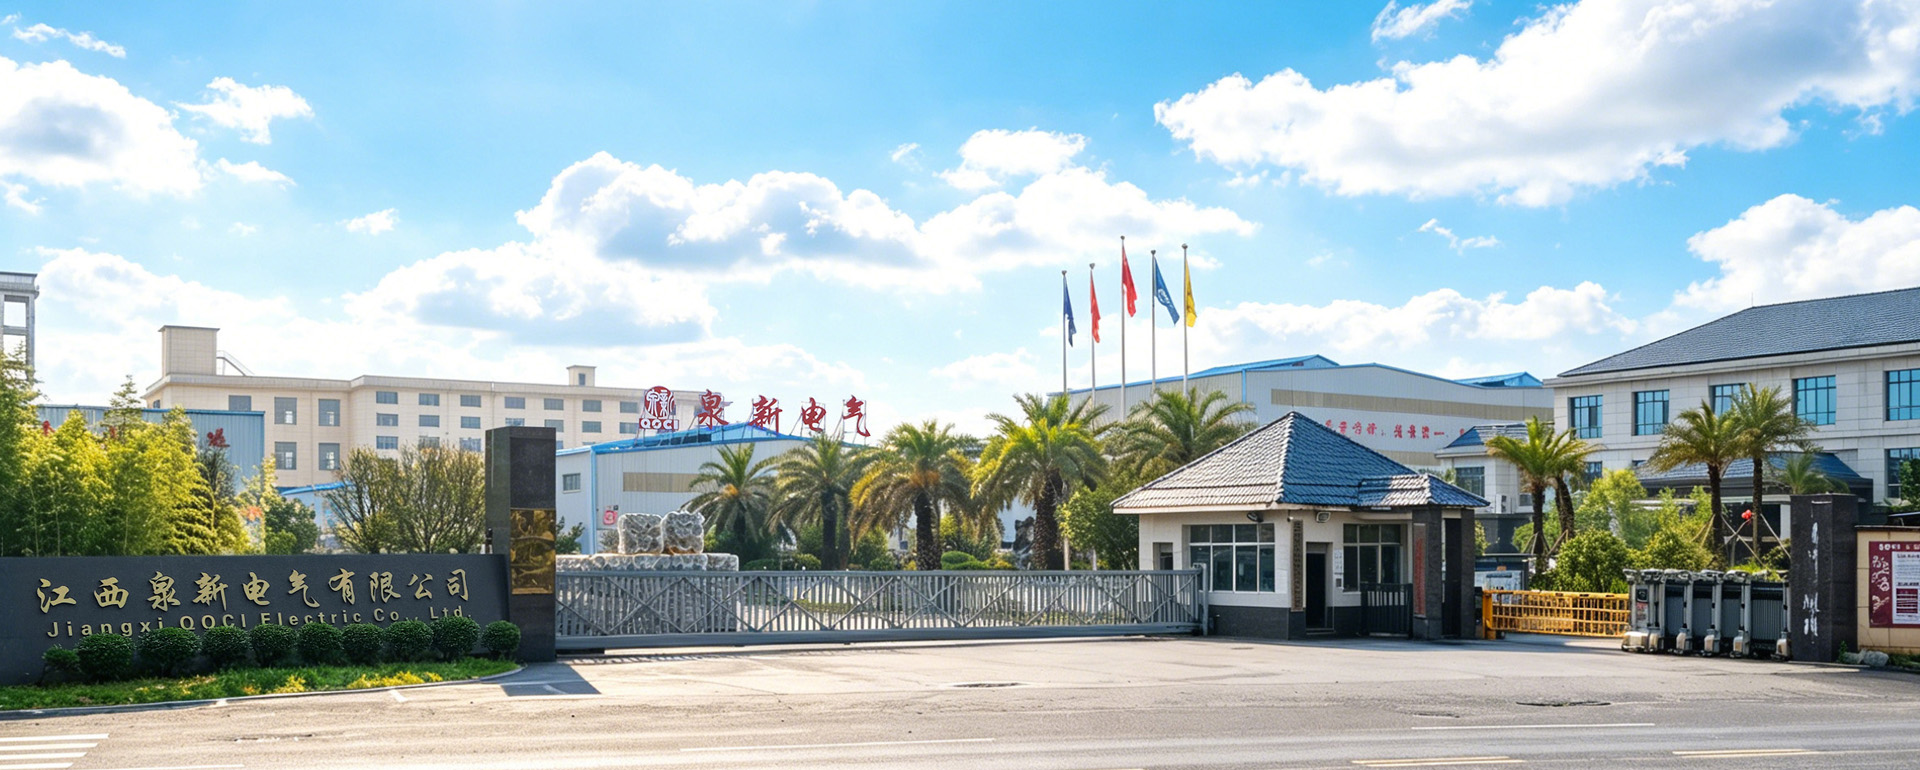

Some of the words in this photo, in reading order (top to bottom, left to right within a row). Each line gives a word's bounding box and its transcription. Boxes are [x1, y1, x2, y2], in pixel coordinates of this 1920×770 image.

[640, 418, 679, 430] QOCI
[697, 388, 871, 437] 泉新电气
[36, 567, 470, 614] 江西泉新电气有限公司
[47, 616, 164, 637] Jiangxi
[180, 613, 247, 632] QOCI
[260, 609, 362, 626] Electric
[429, 605, 472, 620] Ltd.
